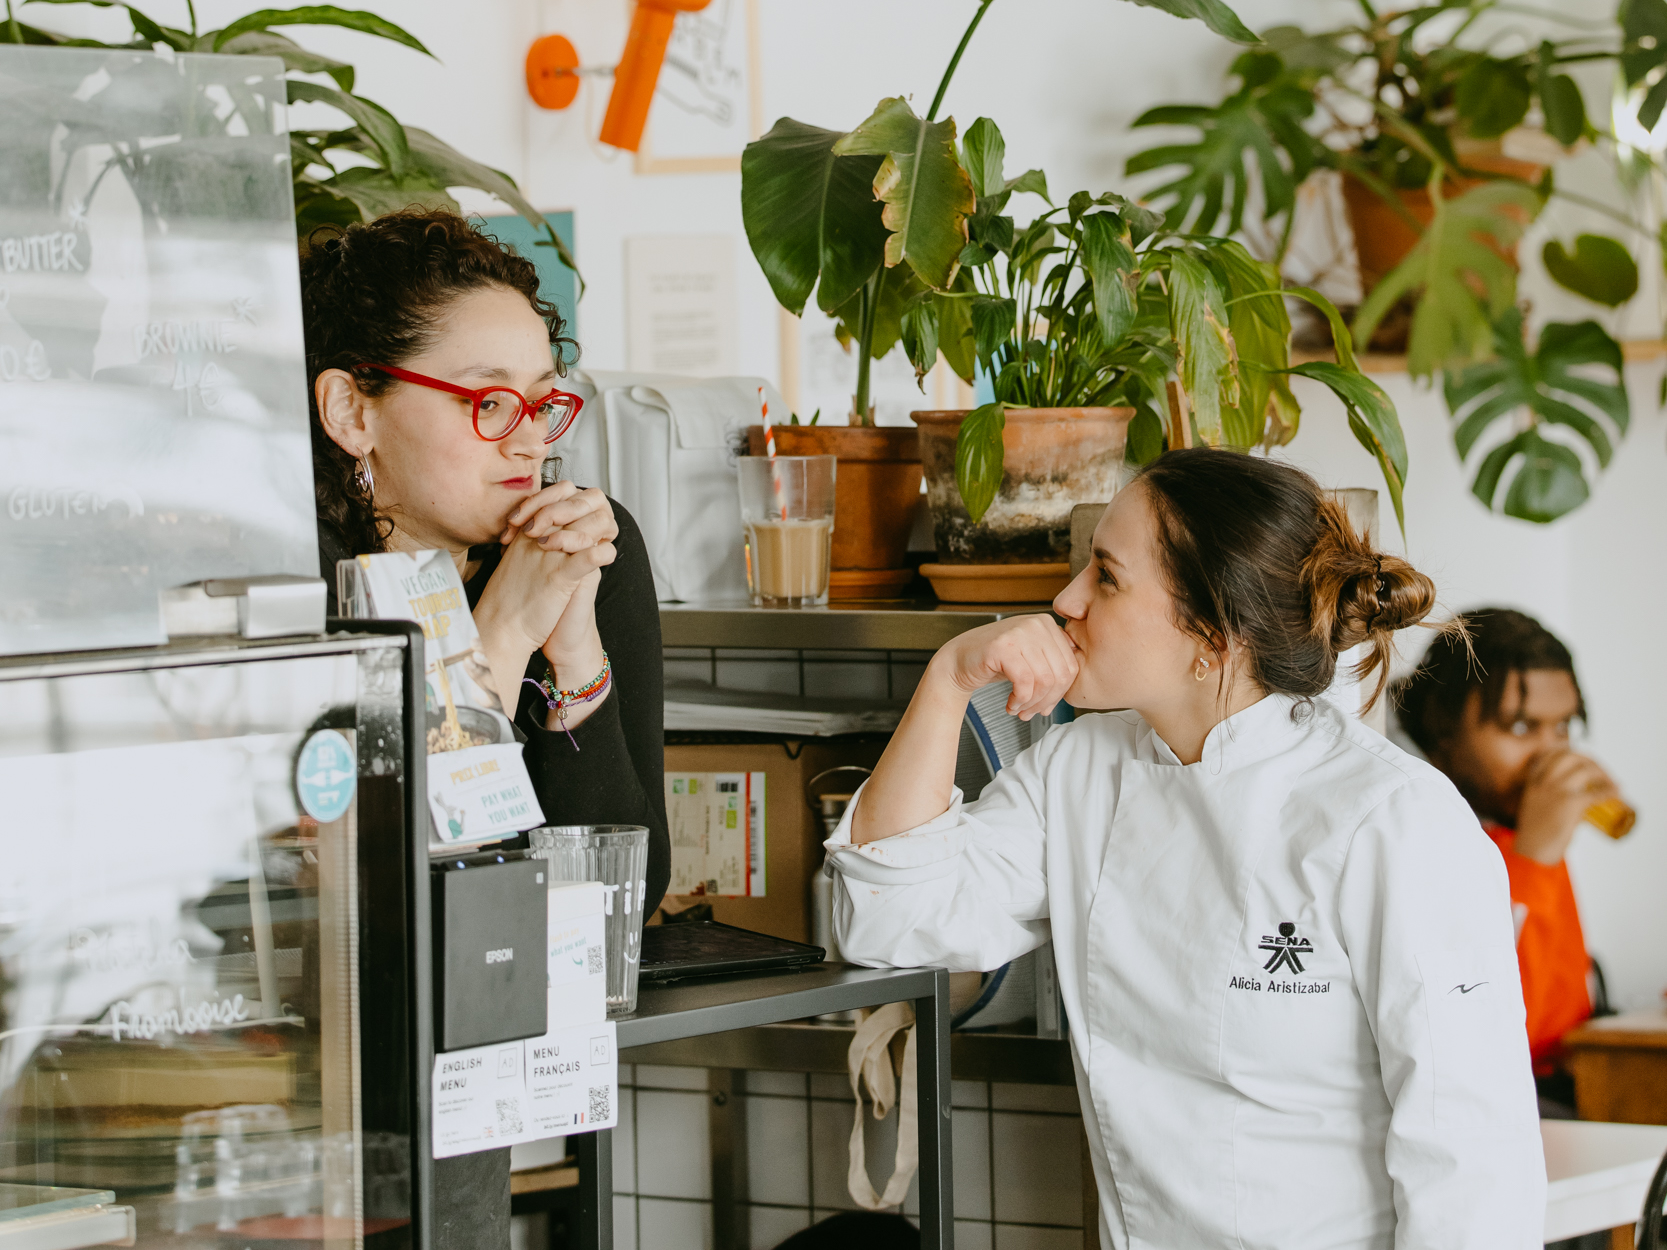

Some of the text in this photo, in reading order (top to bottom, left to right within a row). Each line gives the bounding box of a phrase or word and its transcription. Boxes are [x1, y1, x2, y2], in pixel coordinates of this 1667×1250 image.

[400, 568, 449, 596] VEGAN
[408, 587, 462, 618] TOURIST
[481, 785, 523, 808] PAY WHAT
[488, 801, 531, 824] YOU WANT
[1260, 935, 1312, 946] SENA
[486, 947, 513, 964] EPSON
[1229, 976, 1330, 994] Alicia Aristizabal
[110, 985, 250, 1043] Framboise
[533, 1045, 560, 1059] MENU
[442, 1056, 483, 1074] ENGLISH
[533, 1061, 581, 1078] FRANÇAIS
[440, 1077, 467, 1091] MENU
